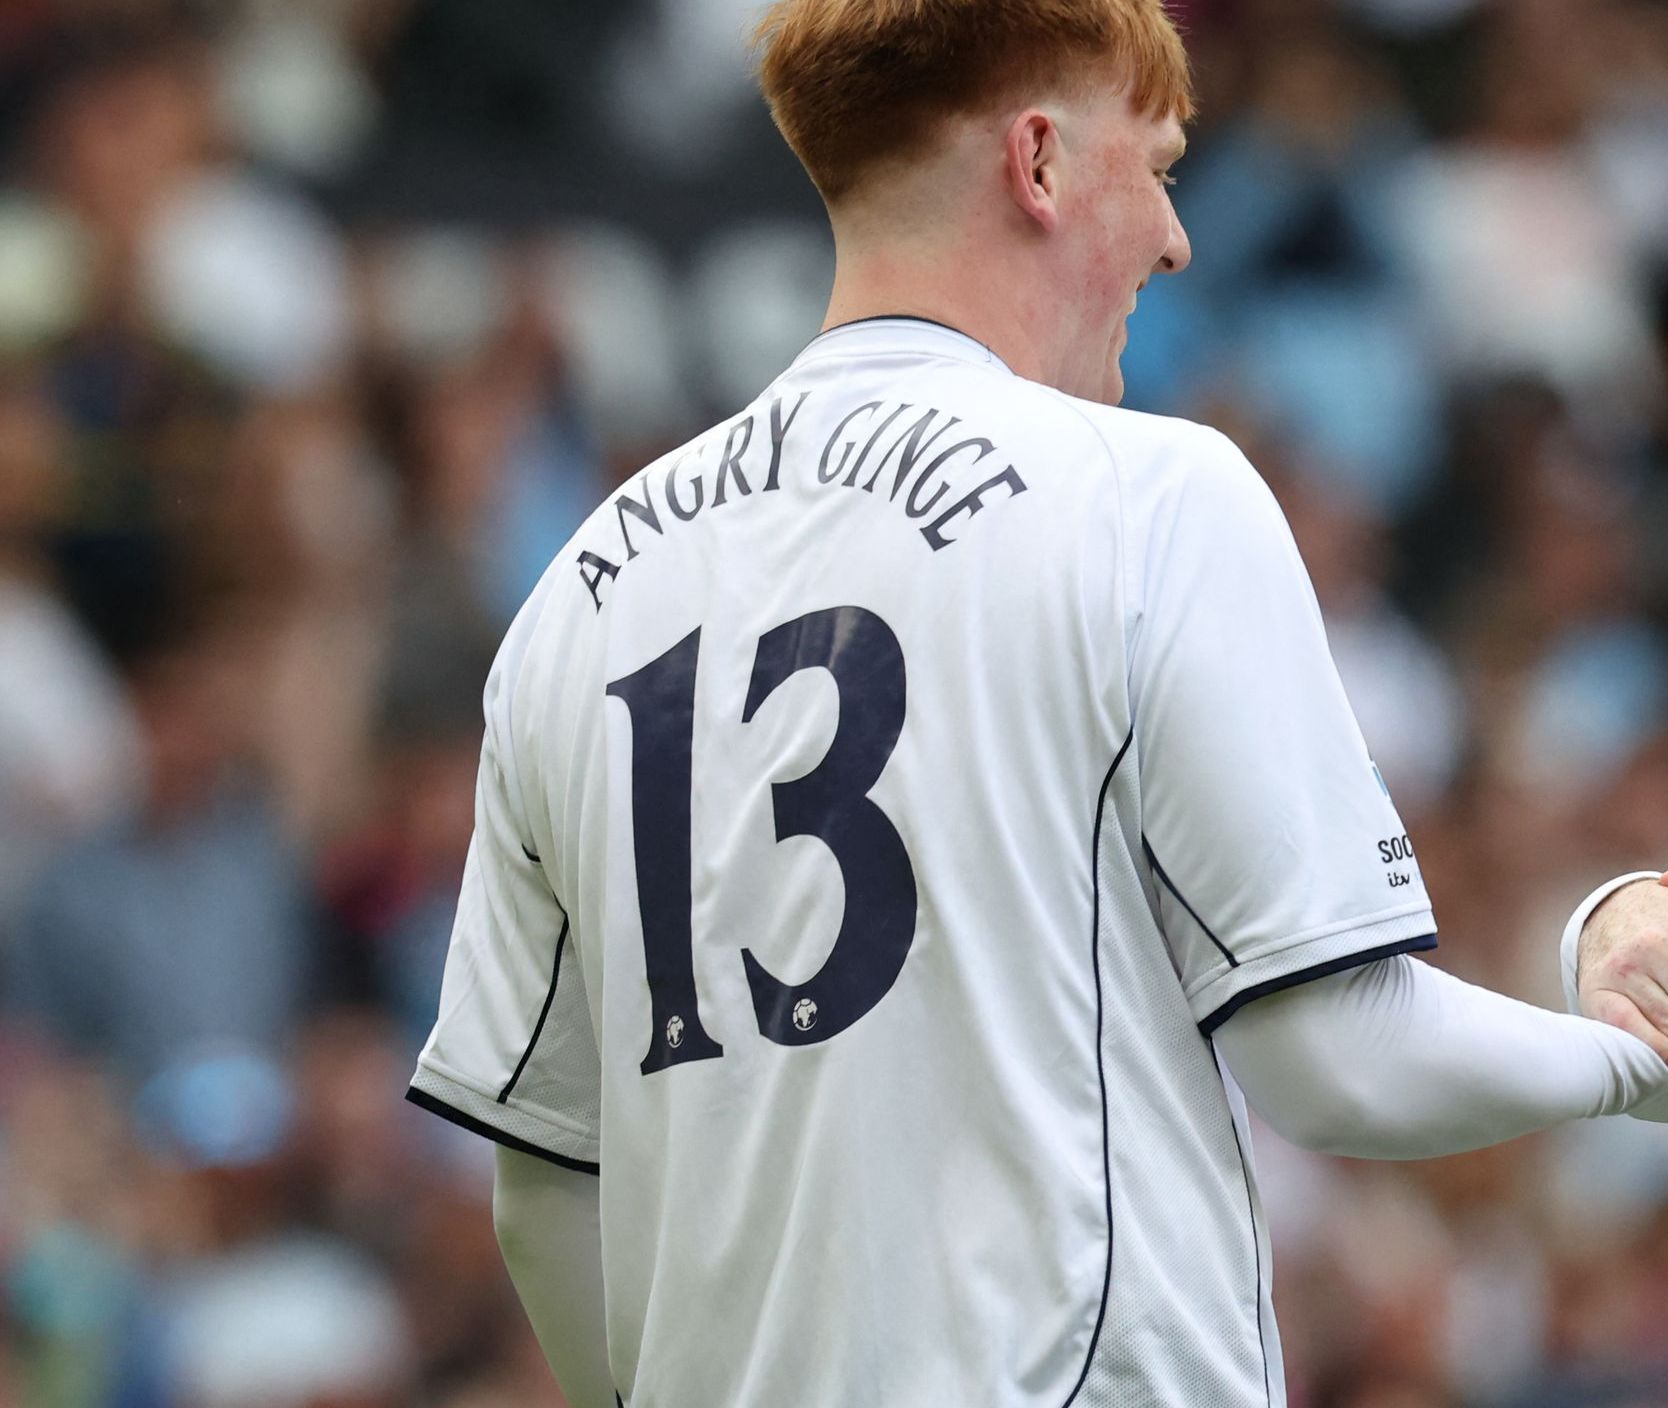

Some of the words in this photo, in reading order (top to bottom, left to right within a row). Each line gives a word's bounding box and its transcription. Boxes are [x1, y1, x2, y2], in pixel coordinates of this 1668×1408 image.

[574, 391, 811, 610] ANGRY
[816, 400, 1028, 553] GINGE
[606, 604, 917, 1076] 13
